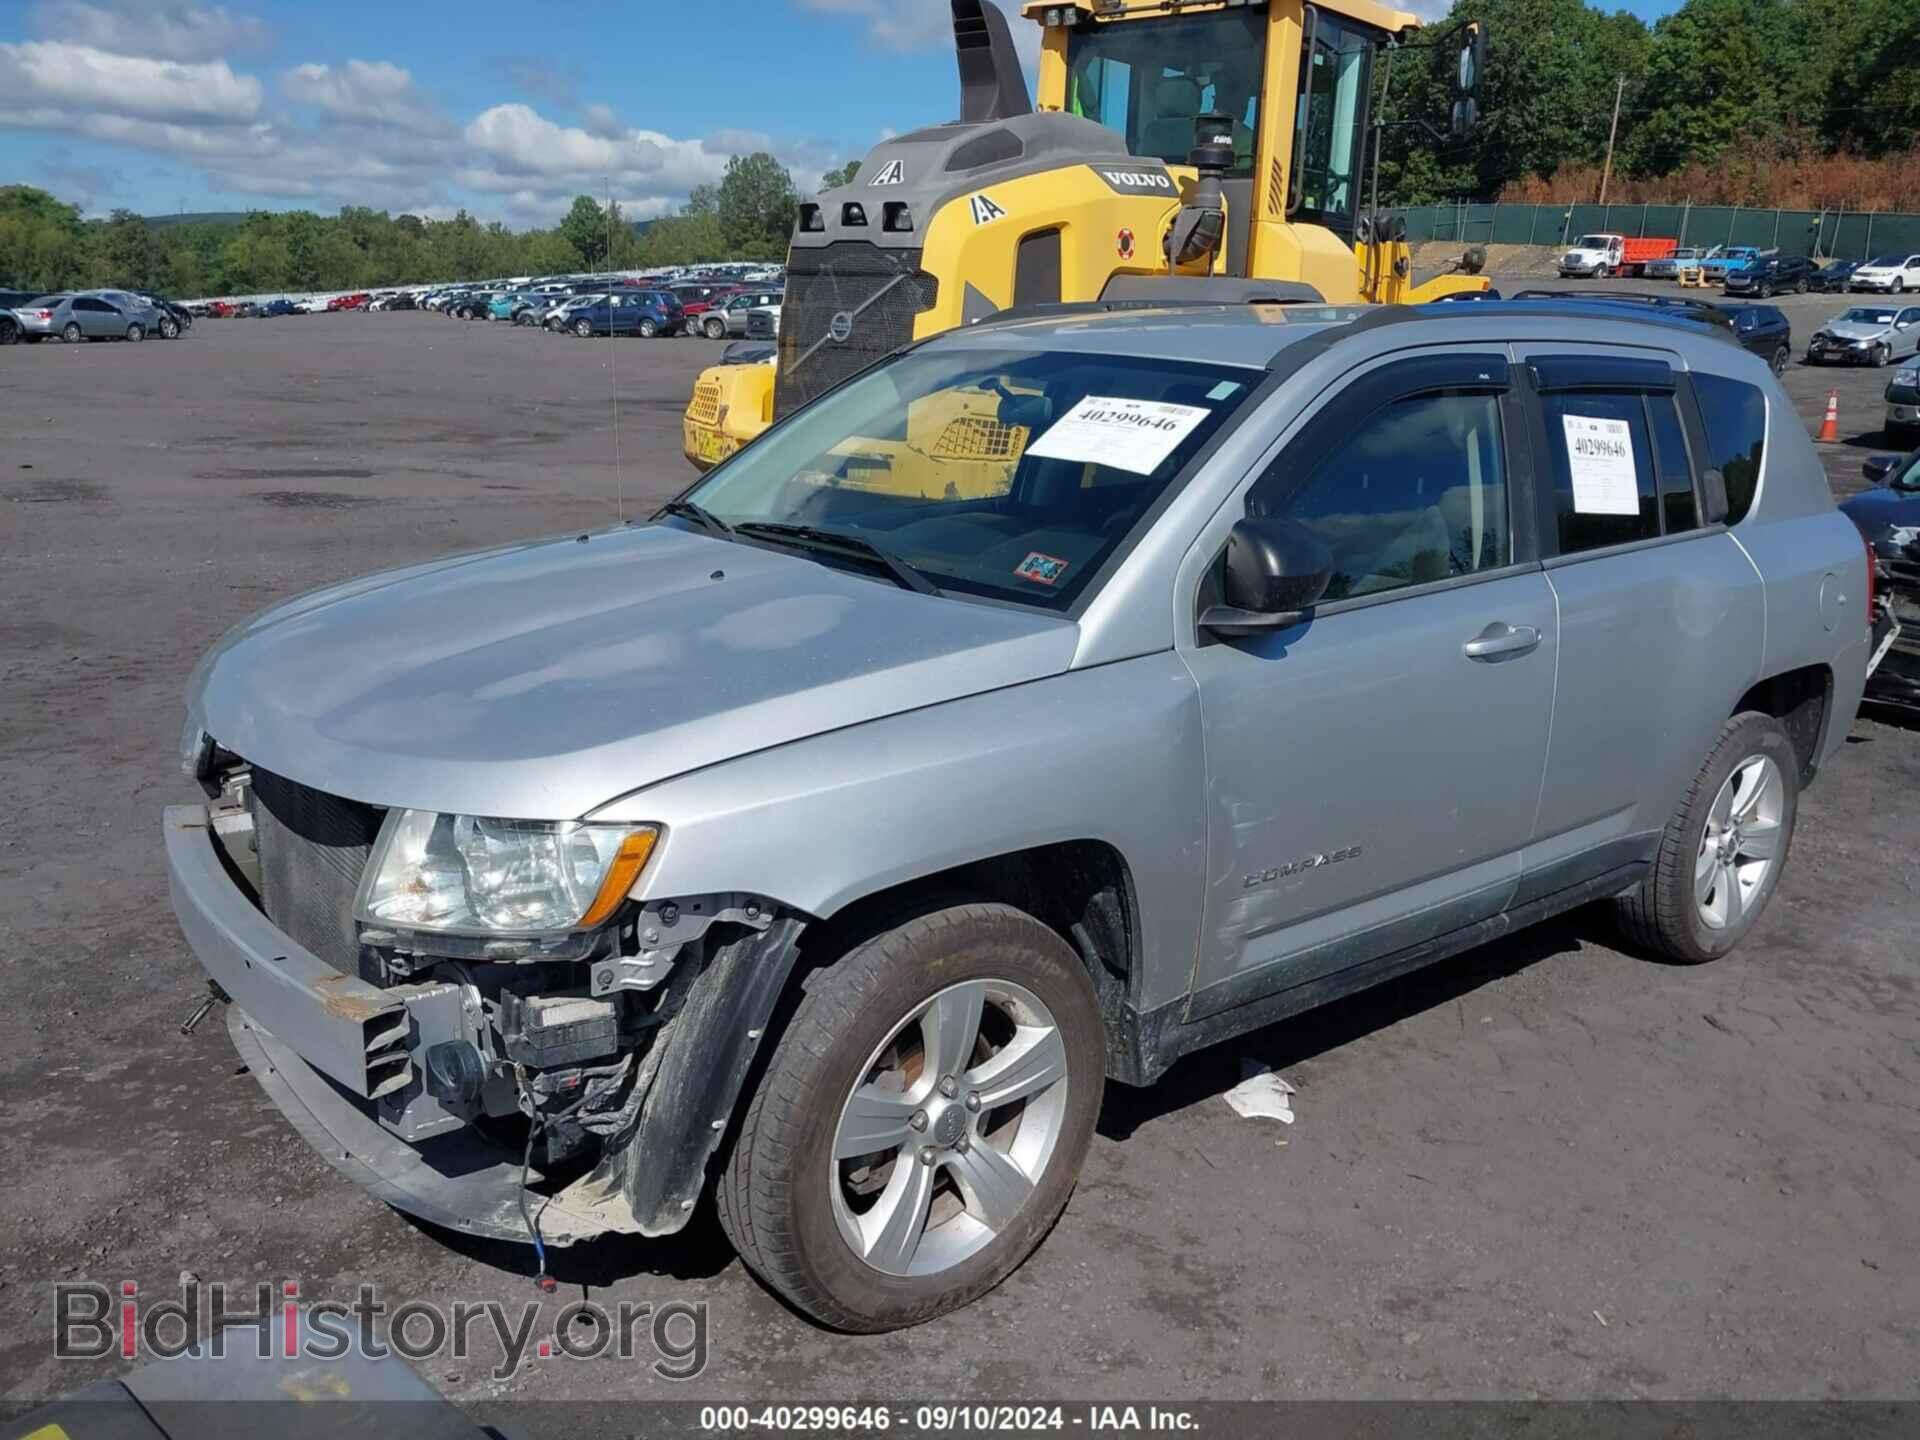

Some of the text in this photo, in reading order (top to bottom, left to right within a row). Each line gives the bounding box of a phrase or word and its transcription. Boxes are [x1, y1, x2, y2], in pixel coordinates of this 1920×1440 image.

[1102, 171, 1170, 188] VOLVO
[1079, 408, 1177, 431] 40299646
[1575, 437, 1626, 458] 40299646
[1243, 846, 1362, 888] COMPASS
